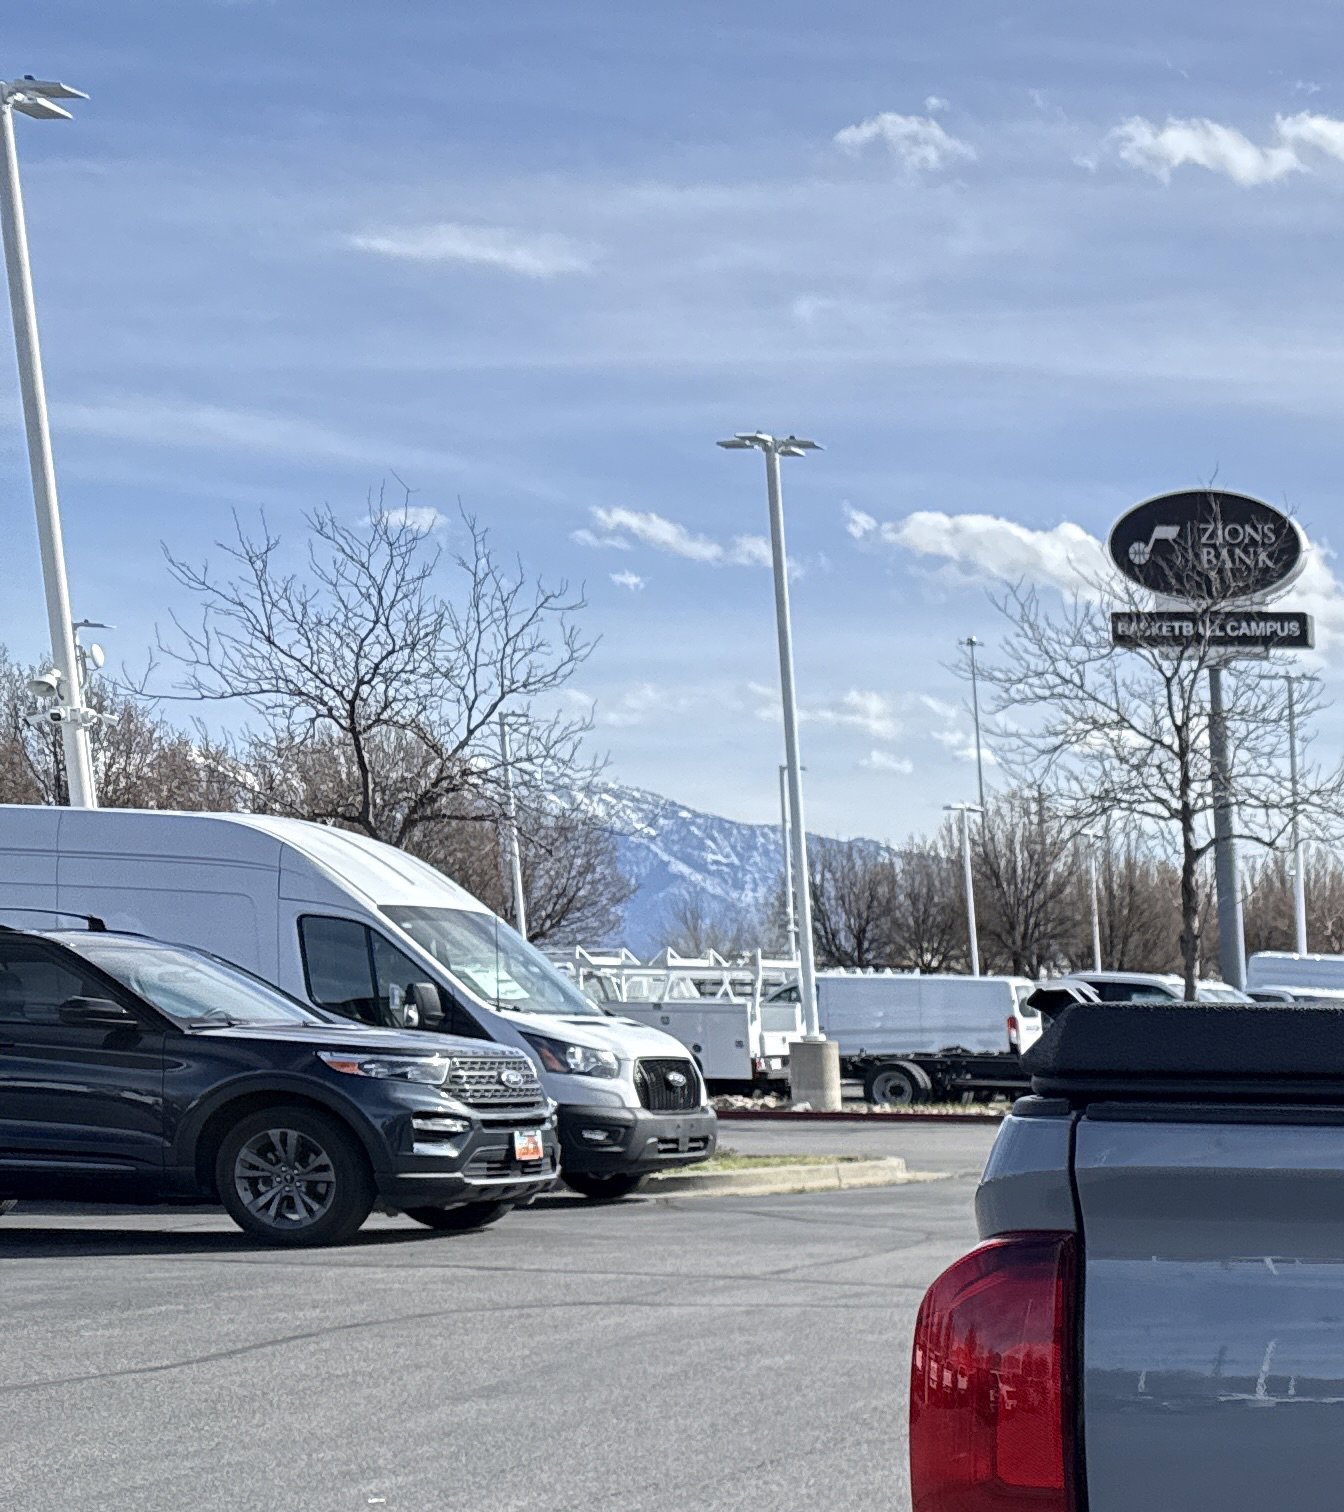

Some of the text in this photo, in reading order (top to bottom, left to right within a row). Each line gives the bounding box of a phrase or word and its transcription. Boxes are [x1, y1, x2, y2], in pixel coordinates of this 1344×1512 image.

[1199, 523, 1275, 544] ZIONS
[1202, 547, 1276, 569] BANK
[1226, 620, 1300, 637] CAMPUS
